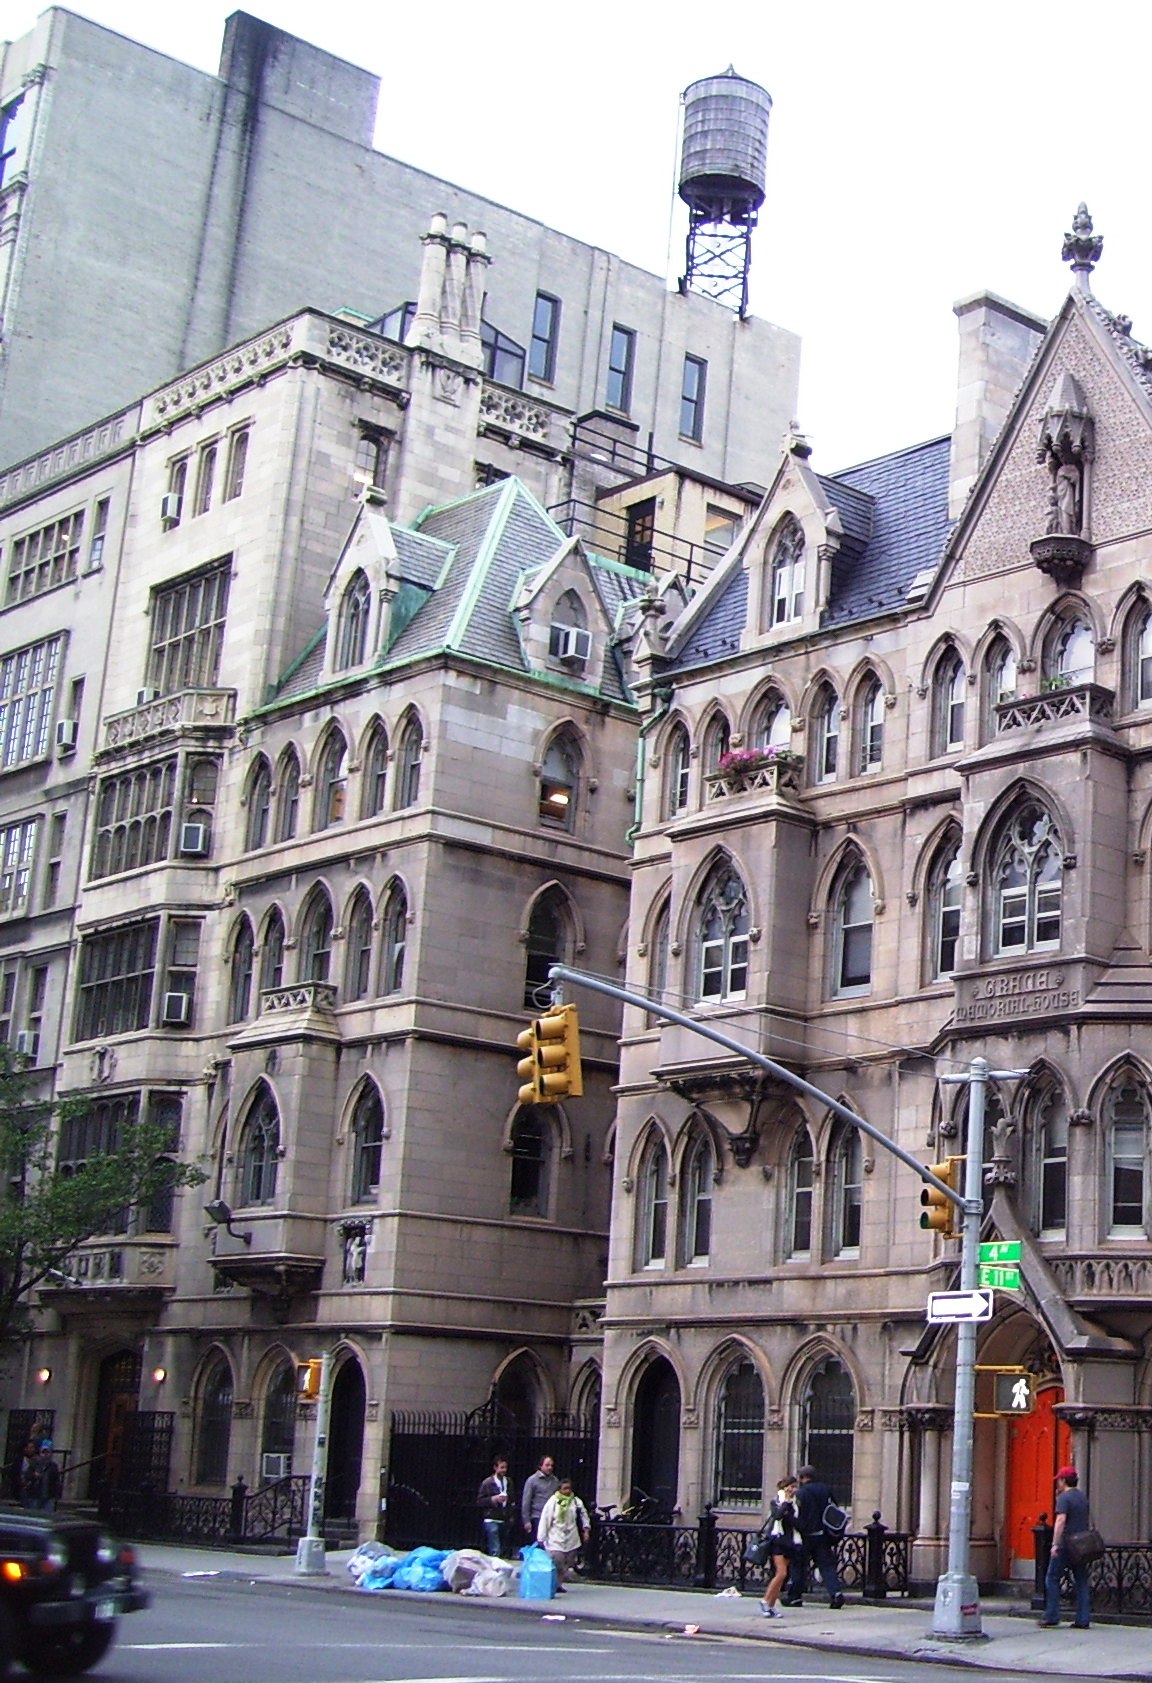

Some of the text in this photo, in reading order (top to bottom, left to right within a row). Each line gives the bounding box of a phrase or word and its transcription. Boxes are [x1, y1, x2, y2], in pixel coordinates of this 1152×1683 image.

[985, 972, 1050, 998] GRACE
[989, 1245, 998, 1260] 4
[981, 1268, 990, 1285] E
[994, 1269, 1004, 1286] 11
